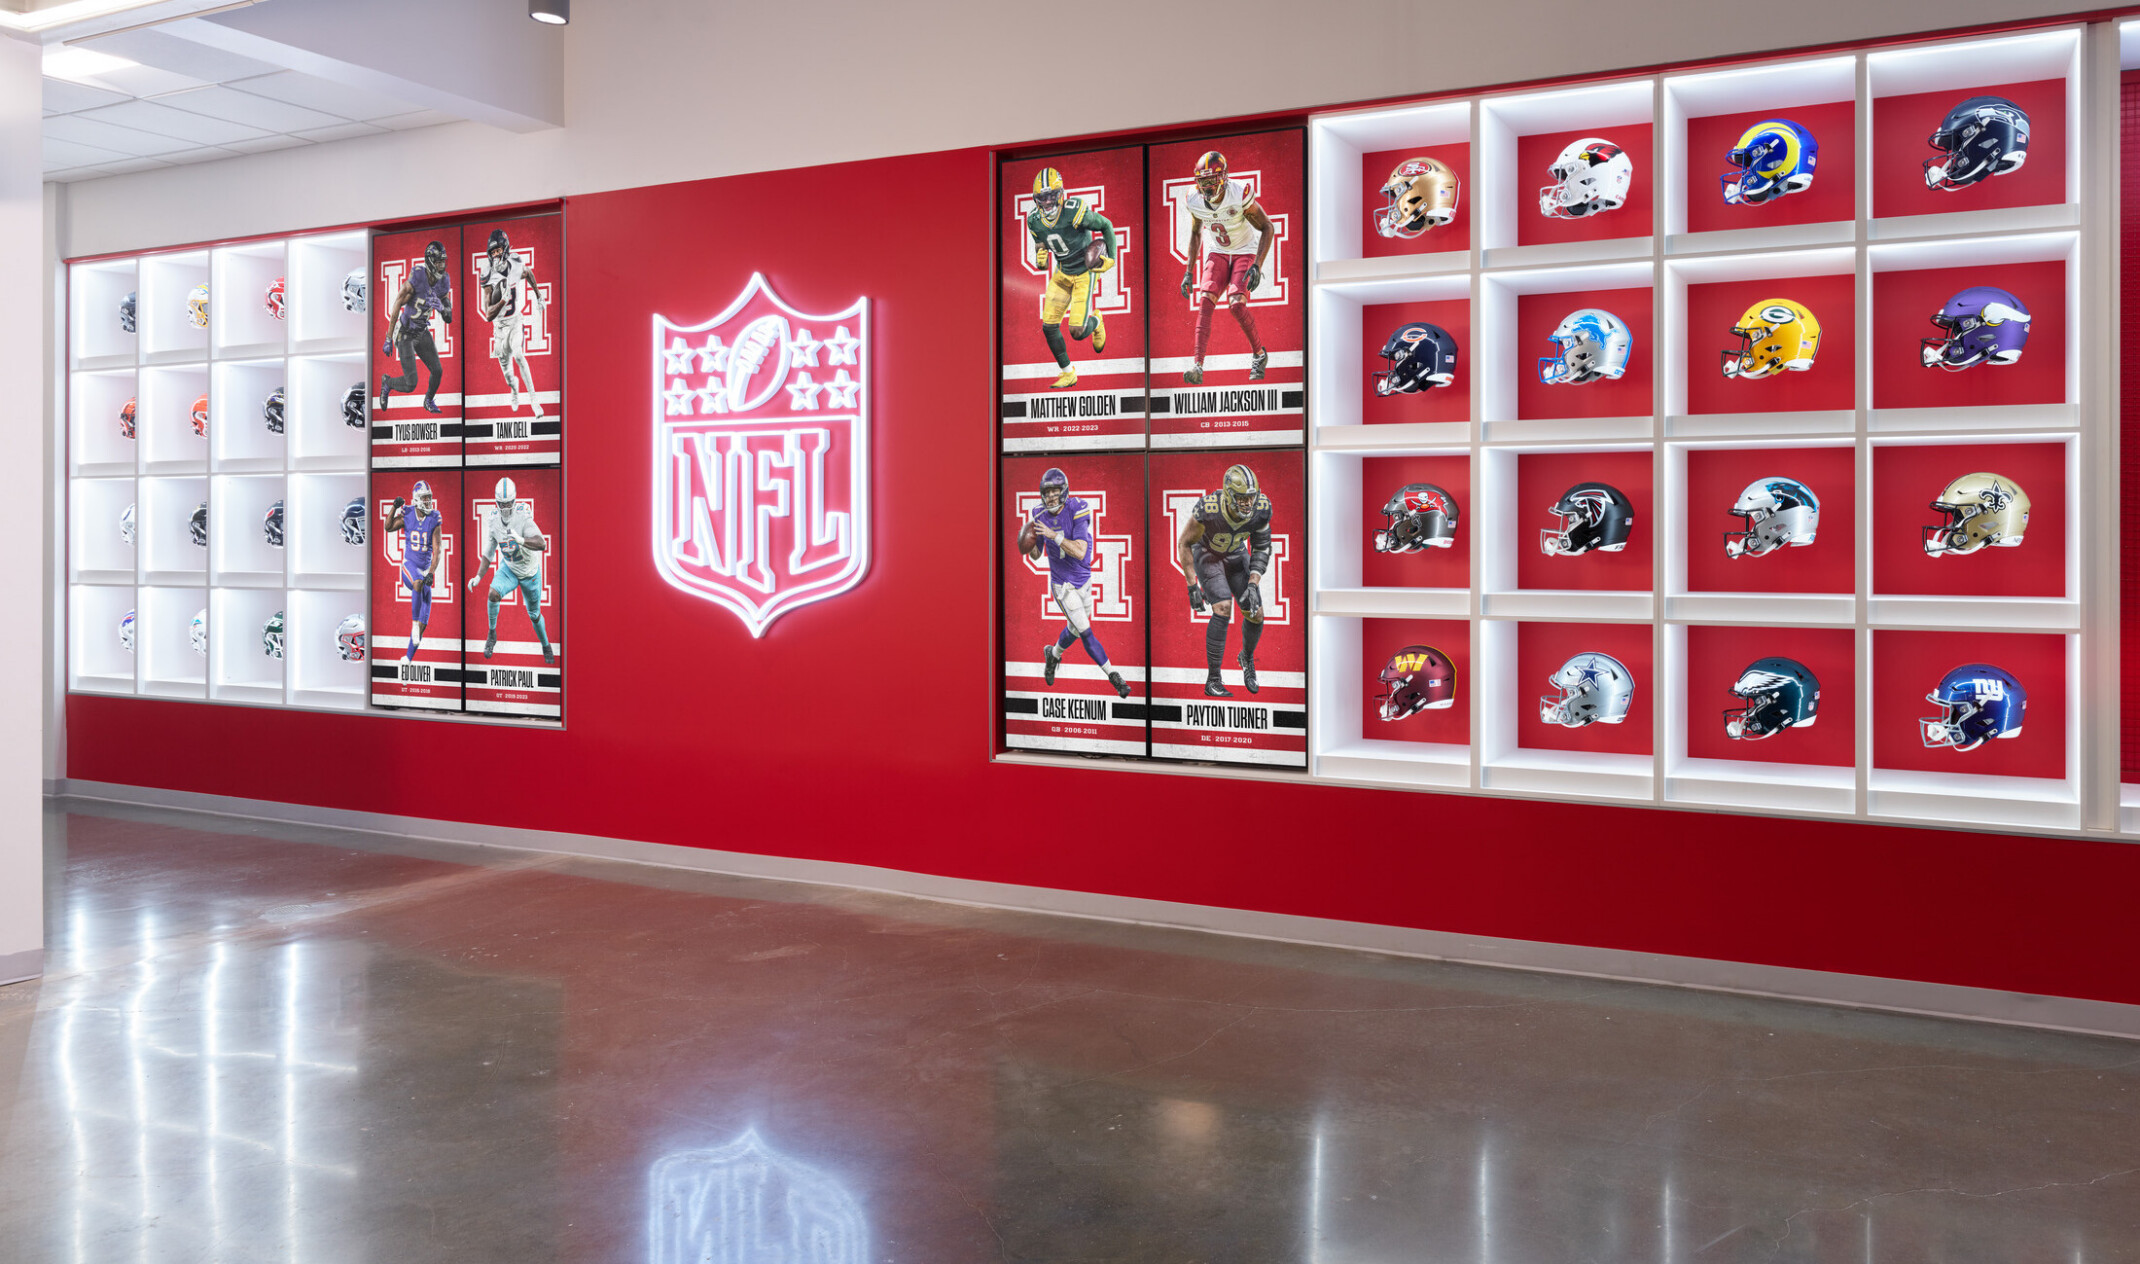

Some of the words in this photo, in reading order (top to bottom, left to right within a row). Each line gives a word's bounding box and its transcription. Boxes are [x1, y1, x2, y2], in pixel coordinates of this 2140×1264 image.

[1046, 233, 1070, 257] 0
[1211, 222, 1231, 248] 3
[1030, 396, 1077, 419] MATTHEW
[1079, 395, 1116, 417] GOLDEN
[1174, 392, 1217, 415] WILLIAM
[1219, 390, 1265, 413] JACKSON
[1267, 389, 1278, 411] III
[395, 424, 411, 441] TYUS
[411, 423, 438, 441] BOWSER
[496, 422, 513, 439] TANK
[513, 421, 528, 438] DELL
[672, 428, 850, 593] NFL
[410, 530, 428, 552] 91
[499, 539, 524, 562] 52
[401, 664, 409, 681] ED
[409, 665, 431, 682] OLIVER
[490, 669, 517, 687] PATRICK
[517, 670, 534, 688] PAUL
[1042, 697, 1066, 719] CASE
[1068, 698, 1107, 721] KEENUM
[1186, 704, 1225, 728] PAYTON
[1227, 706, 1268, 730] TURNER
